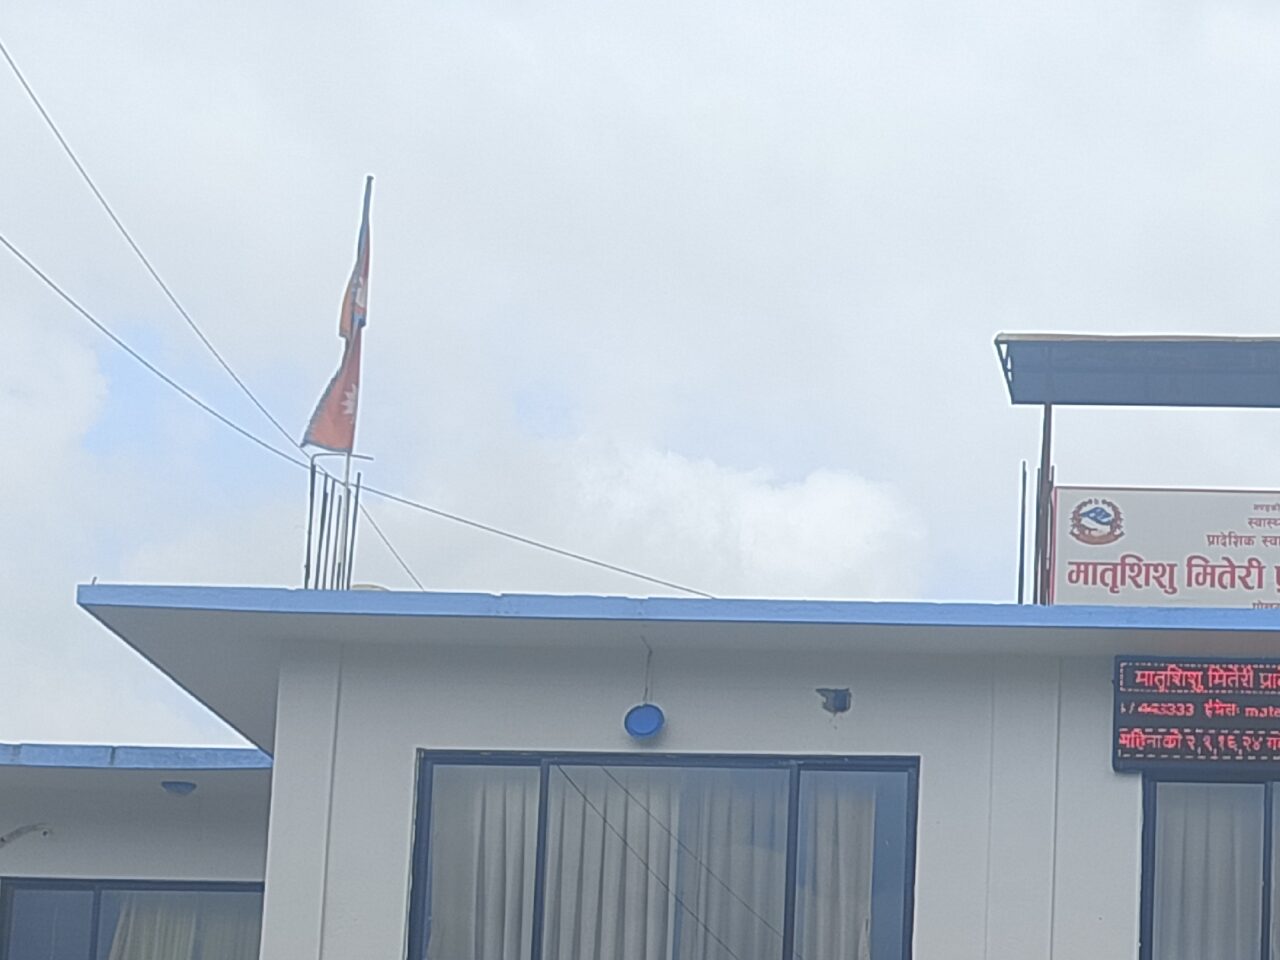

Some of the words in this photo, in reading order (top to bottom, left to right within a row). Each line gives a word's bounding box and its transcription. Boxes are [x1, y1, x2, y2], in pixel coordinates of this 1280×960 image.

[1206, 532, 1256, 548] प्रादेशिक
[1067, 554, 1178, 594] मातृशिशु
[1186, 555, 1266, 590] मितेरी
[1136, 666, 1203, 692] मातृशिशु
[1208, 665, 1254, 688] मितेरी
